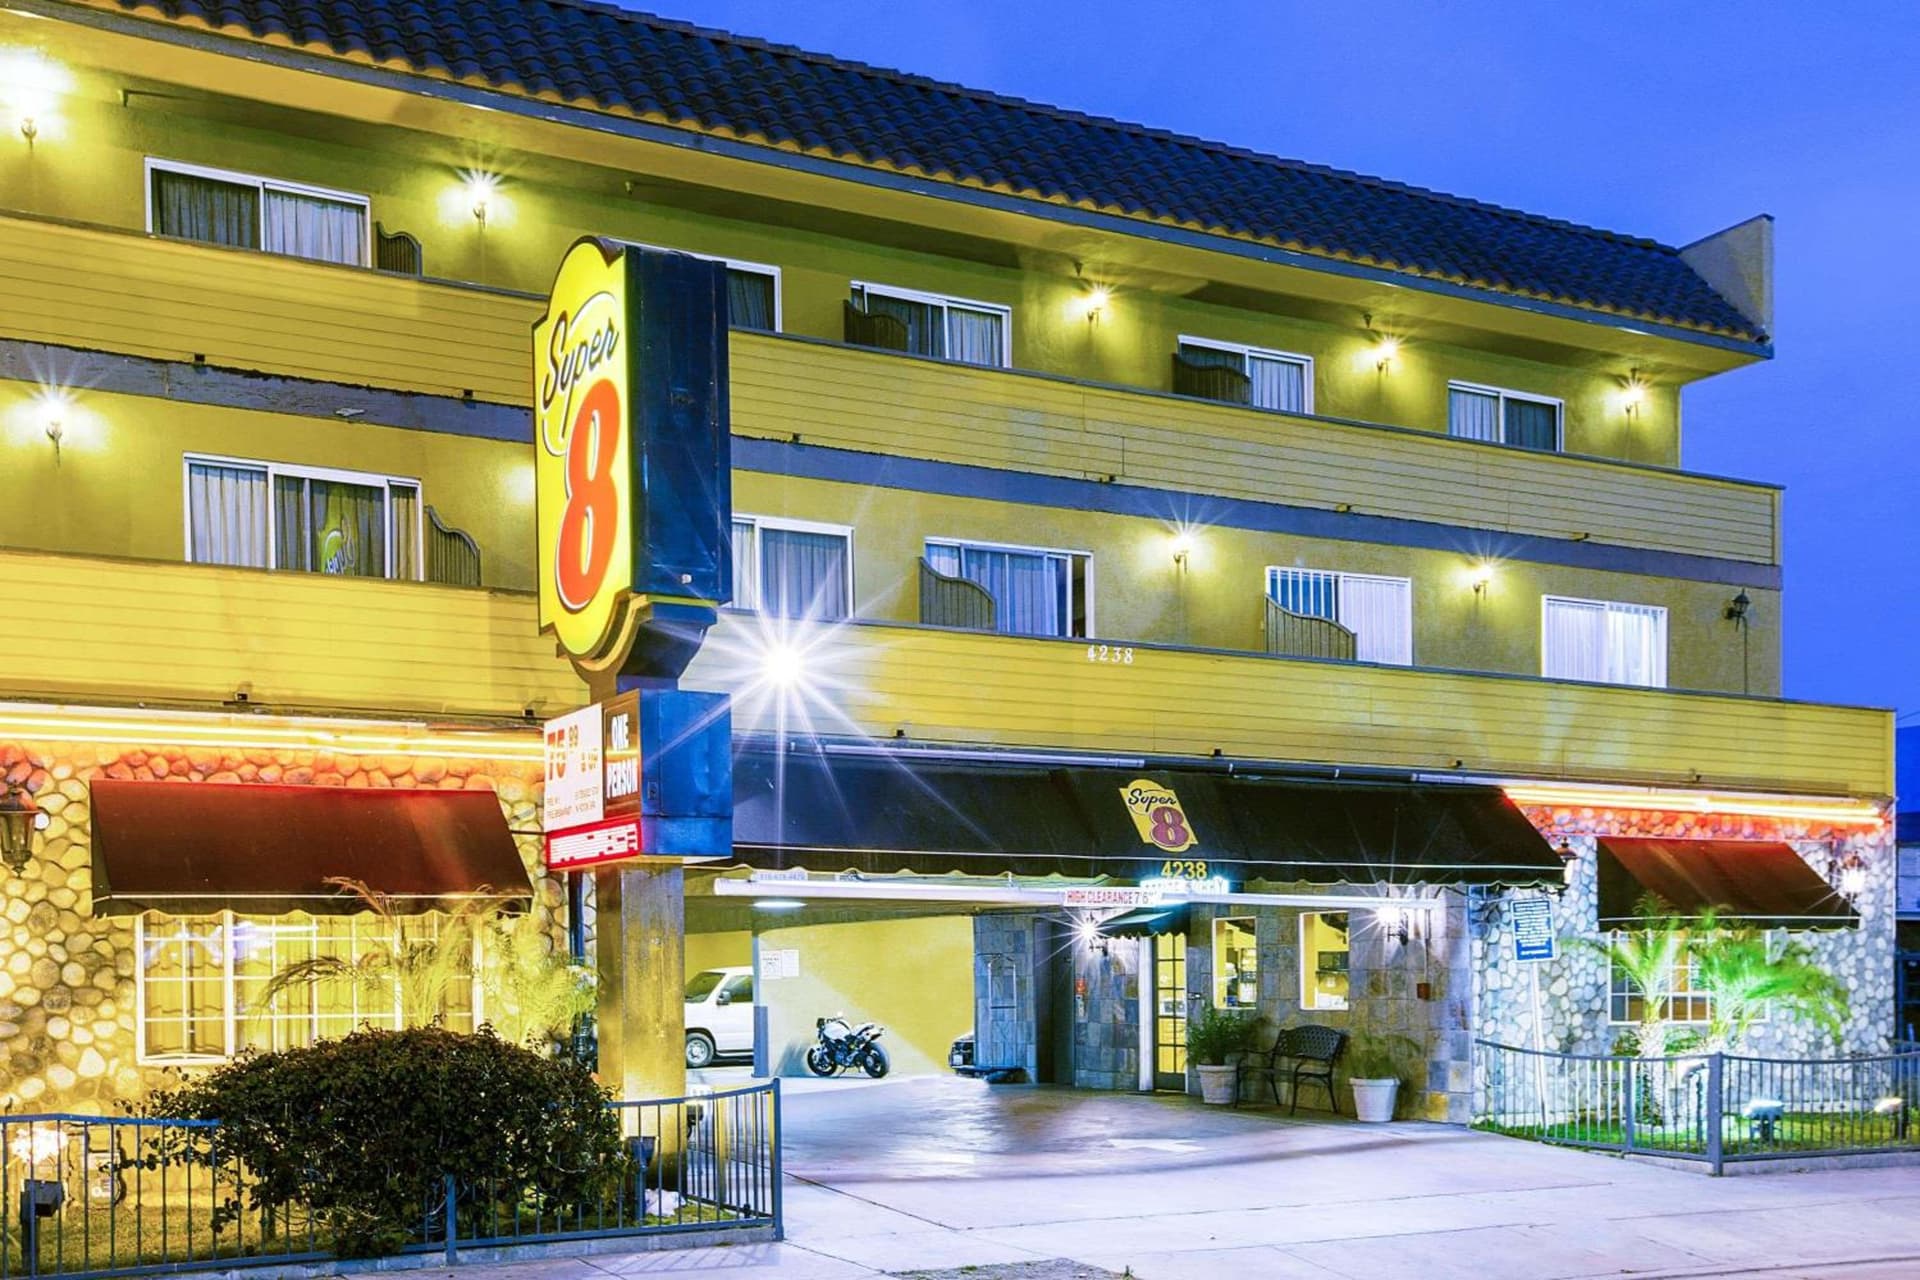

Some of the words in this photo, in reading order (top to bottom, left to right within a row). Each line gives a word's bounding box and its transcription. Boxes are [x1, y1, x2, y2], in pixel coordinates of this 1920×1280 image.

[542, 312, 618, 438] Super
[556, 379, 619, 610] 8
[1088, 645, 1133, 664] 4238
[611, 713, 629, 752] ONE
[607, 760, 637, 797] PERSON
[1129, 788, 1177, 811] Super
[1151, 806, 1188, 846] 8
[1161, 862, 1207, 880] 4238
[1088, 891, 1133, 904] CLEARANCE
